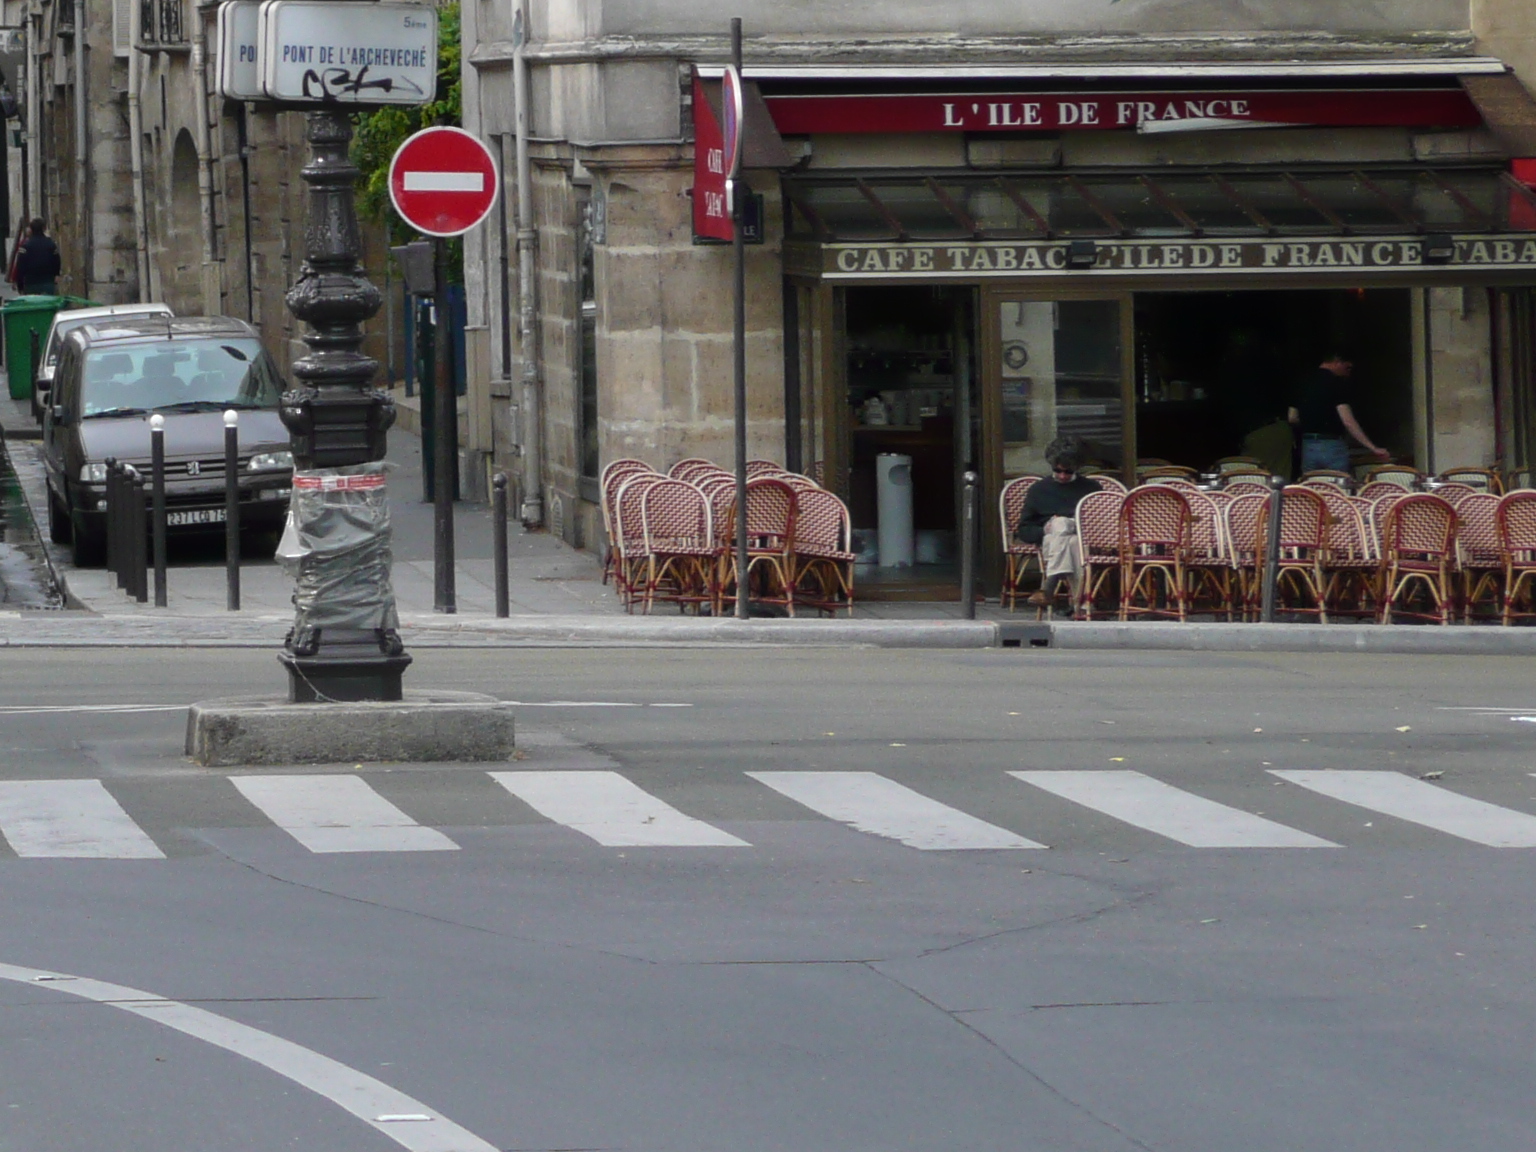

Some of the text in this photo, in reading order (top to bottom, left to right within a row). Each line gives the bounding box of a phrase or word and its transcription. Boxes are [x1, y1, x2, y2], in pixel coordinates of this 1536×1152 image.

[283, 45, 426, 67] PONT DE L'ARCHEVECHÉ
[943, 100, 1250, 126] L'ILE DE FRANCE
[837, 248, 934, 272] CAFE
[948, 246, 1068, 270] TABAC
[1262, 242, 1422, 266] FRANCE
